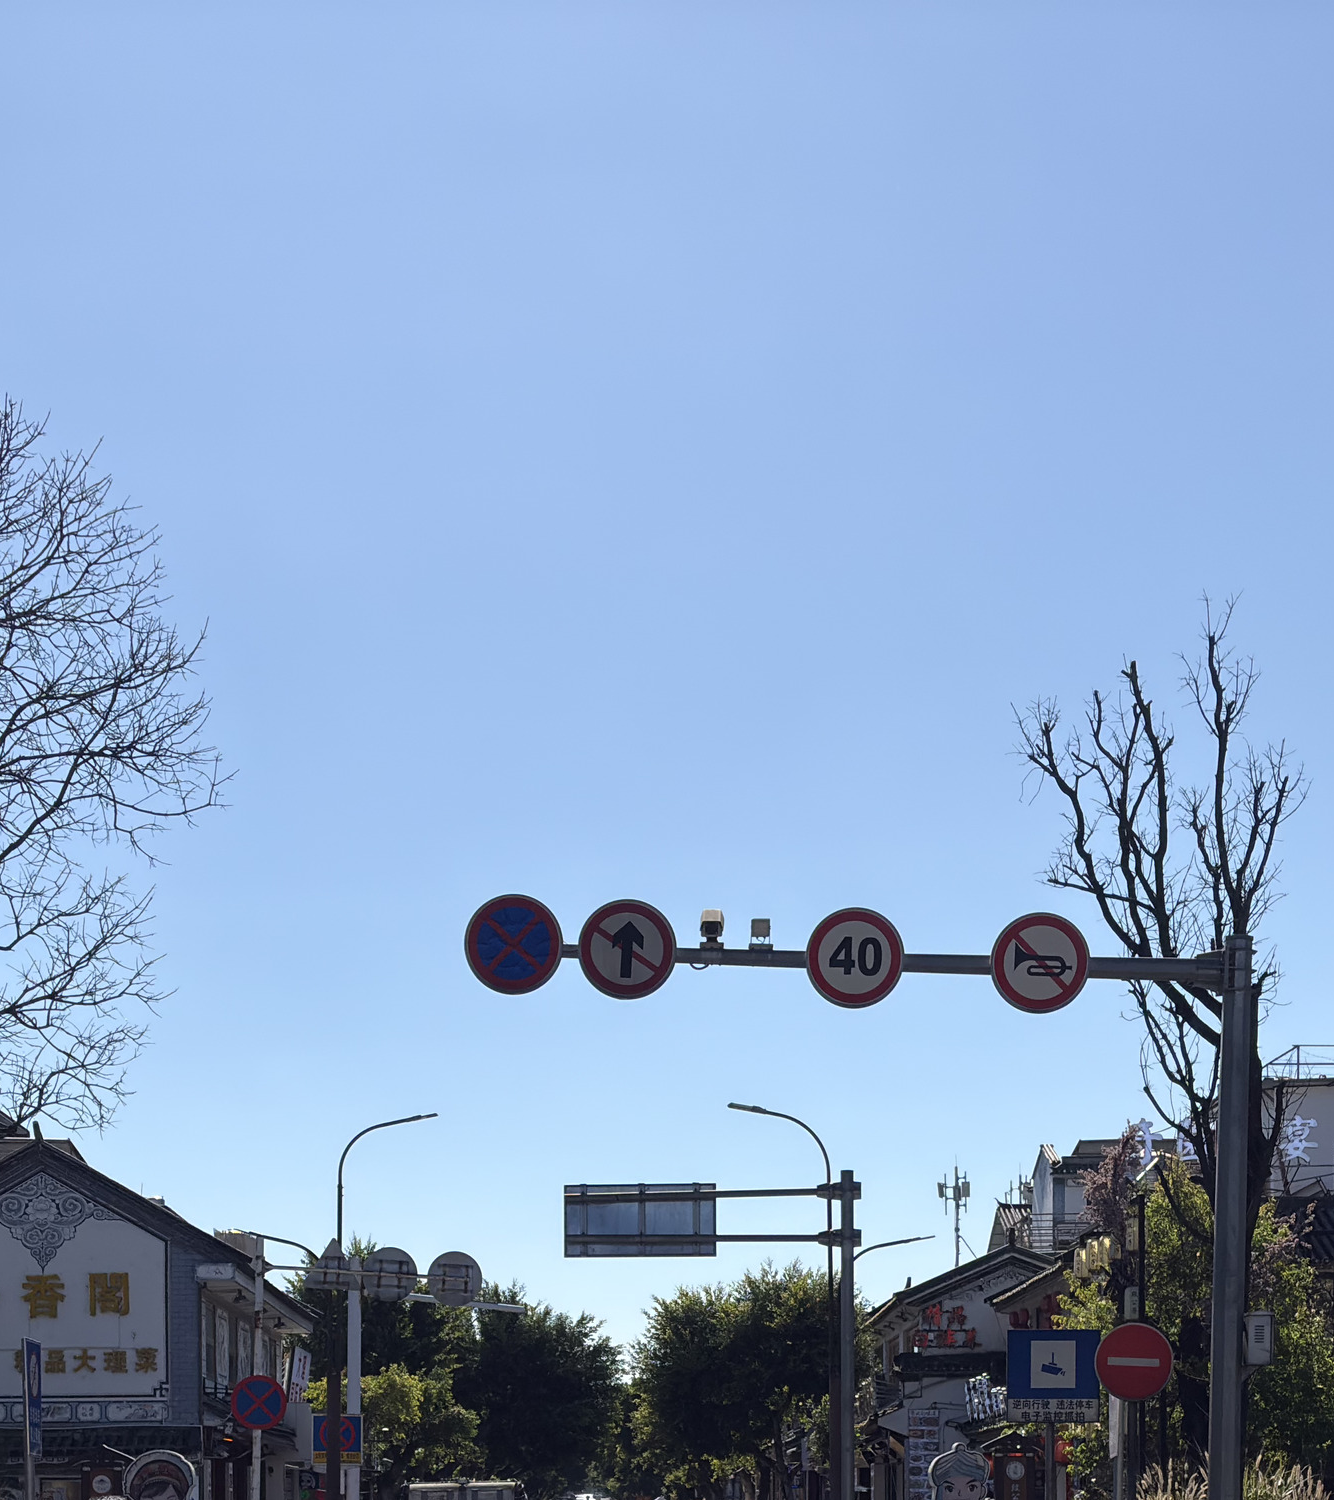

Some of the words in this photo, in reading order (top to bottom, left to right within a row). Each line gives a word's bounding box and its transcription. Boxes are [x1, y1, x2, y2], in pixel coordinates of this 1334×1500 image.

[829, 936, 883, 976] 40
[1013, 1400, 1051, 1410] 逆向行驶
[1056, 1400, 1094, 1410] 违法停车
[1021, 1411, 1085, 1422] 电子监控抓拍
